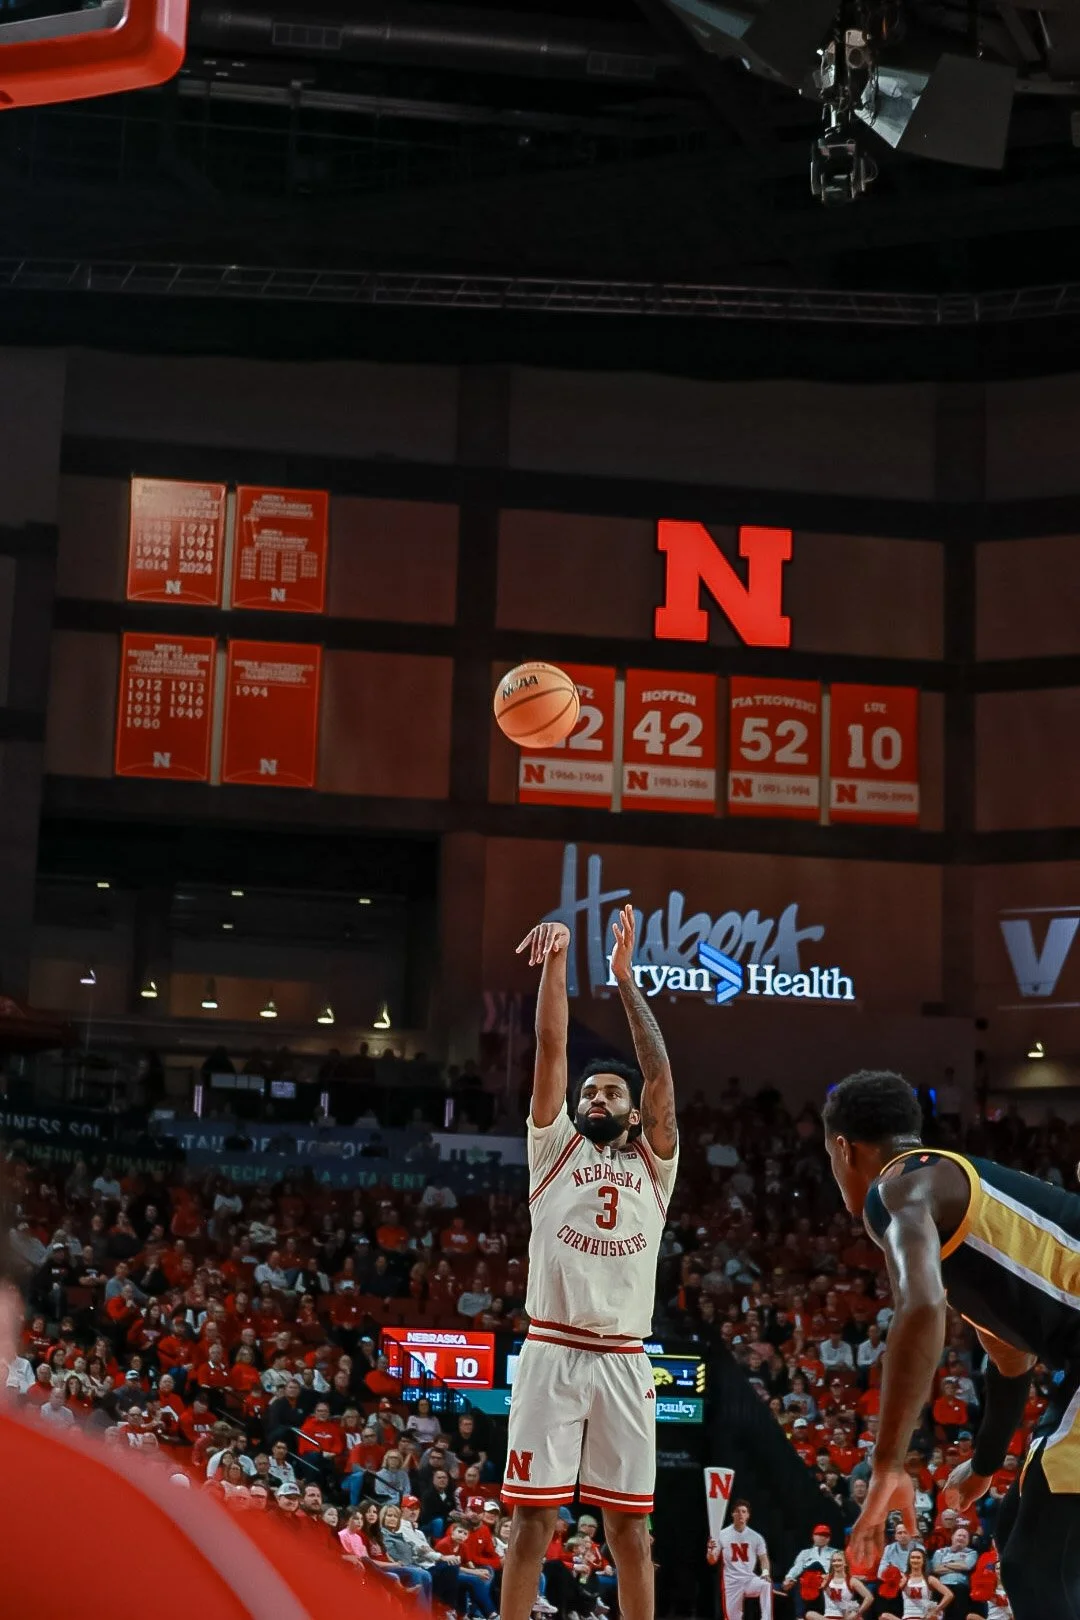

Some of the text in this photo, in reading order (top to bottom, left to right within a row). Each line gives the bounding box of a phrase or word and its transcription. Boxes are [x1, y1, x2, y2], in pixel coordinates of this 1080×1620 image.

[136, 546, 170, 558] 1994
[135, 558, 212, 575] 2014 2024
[165, 580, 181, 595] N
[655, 519, 792, 648] N
[270, 587, 286, 603] N
[128, 678, 204, 693] 1912 1913
[236, 685, 268, 697] 1994
[128, 691, 204, 706] 1914 1916
[731, 695, 817, 714] PIATKOWSKI
[864, 702, 888, 714] LUE
[169, 706, 203, 719] 1949
[553, 705, 604, 751] 2
[632, 711, 703, 758] 42
[739, 717, 808, 765] 52
[847, 723, 902, 770] 10
[153, 752, 171, 768] N
[260, 758, 277, 775] N
[523, 763, 546, 784] N
[627, 770, 648, 791] N
[732, 777, 753, 798] N
[836, 784, 857, 804] N
[746, 963, 856, 1000] Health
[358, 1171, 426, 1189] TAENT
[571, 1163, 643, 1195] NEBRASKA
[596, 1186, 619, 1230] 3
[556, 1224, 648, 1257] CORNHUSKERS
[406, 1332, 467, 1345] NEBRASKA
[455, 1357, 478, 1378] 10
[507, 1449, 533, 1482] N
[709, 1471, 732, 1501] N
[731, 1543, 750, 1563] N
